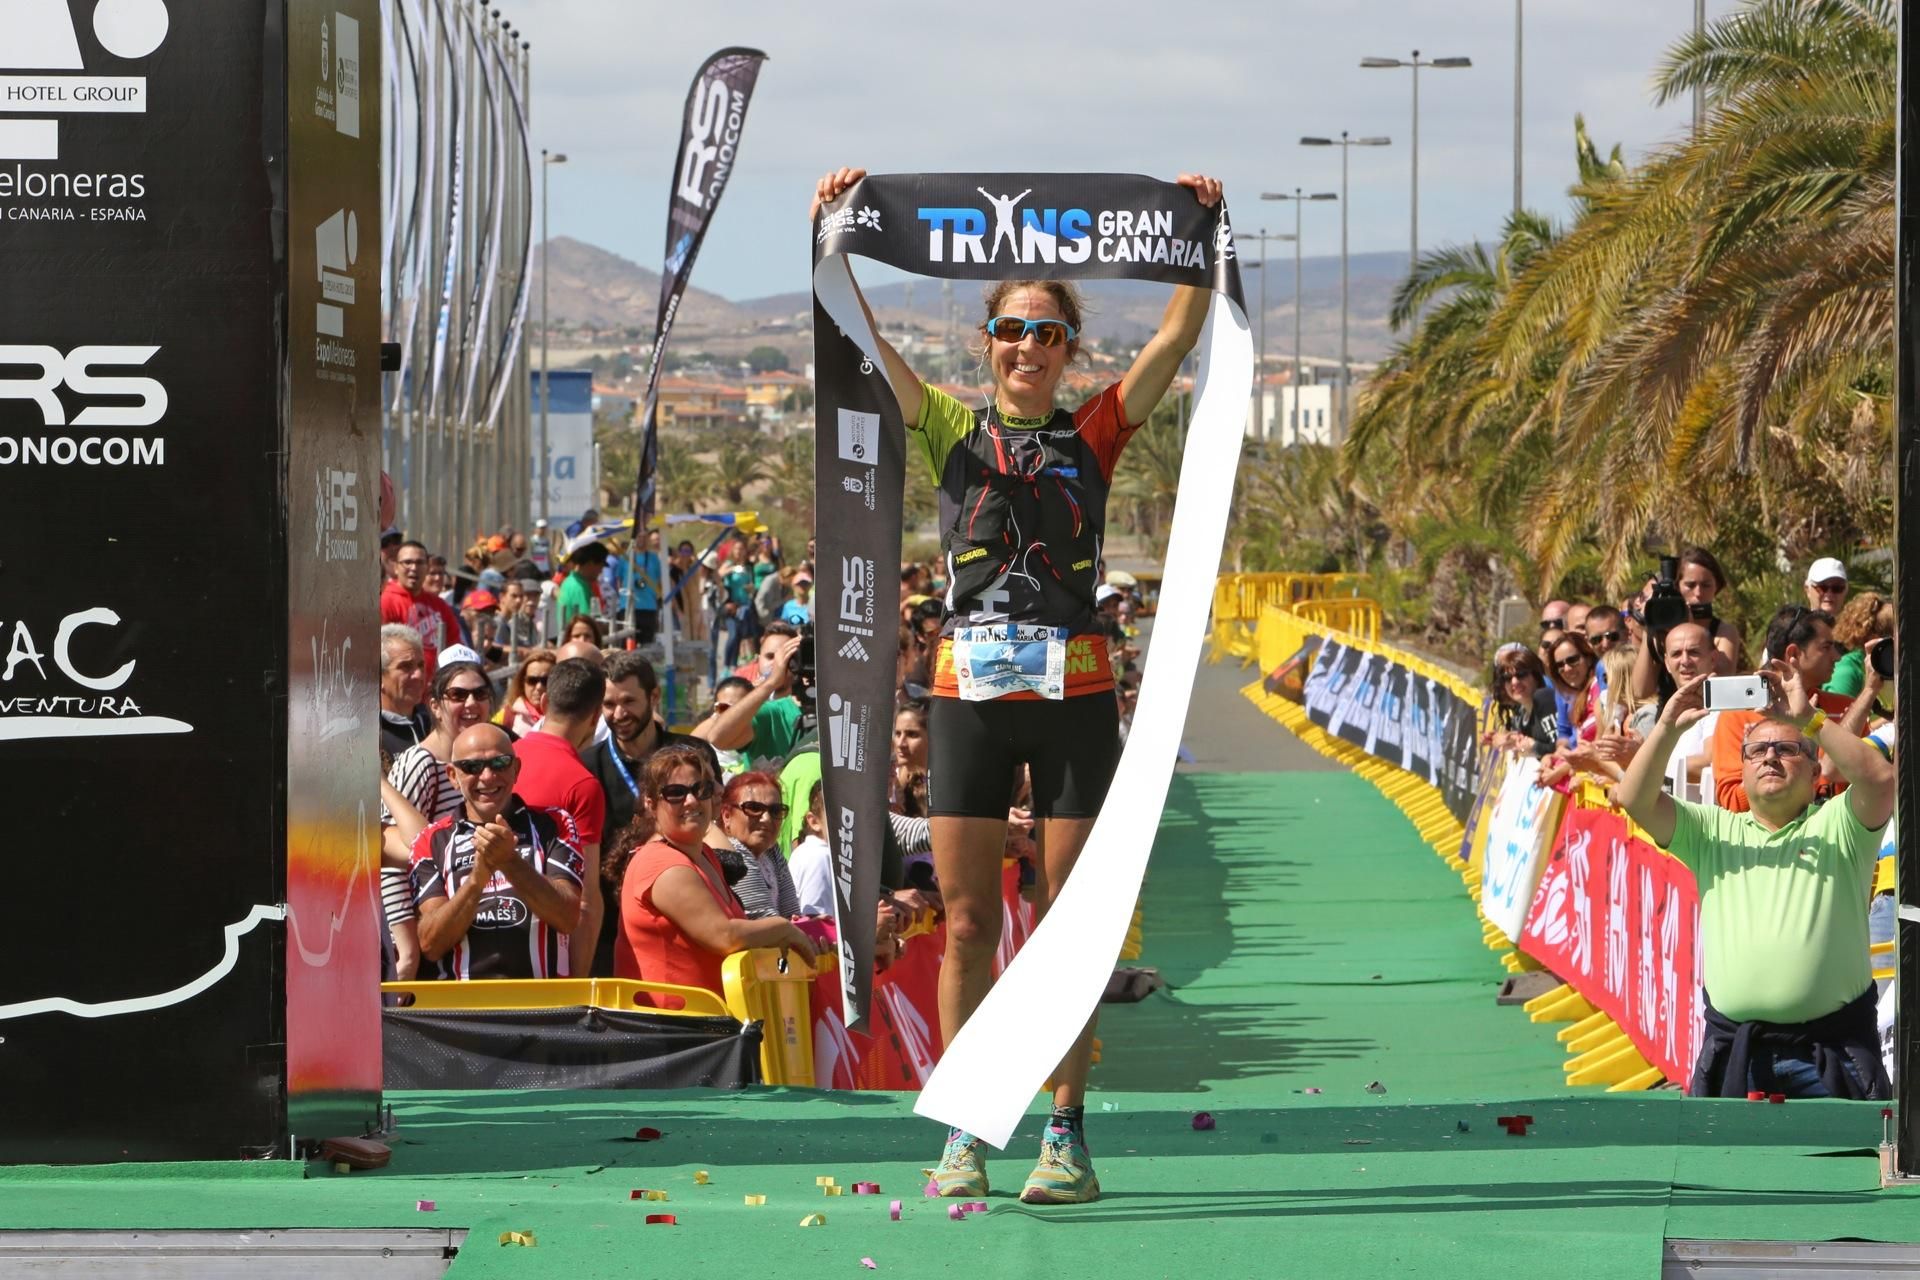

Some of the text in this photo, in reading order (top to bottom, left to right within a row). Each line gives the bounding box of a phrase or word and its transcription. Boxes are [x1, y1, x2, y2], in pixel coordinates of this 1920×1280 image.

[8, 86, 138, 101] HOTEL GROUP
[677, 76, 729, 208] RS
[8, 207, 75, 221] CANARIA
[91, 206, 146, 222] ESPAÑA
[1098, 211, 1172, 237] GRAN
[1097, 236, 1206, 270] CANARIA
[0, 345, 168, 426] RS
[865, 560, 875, 624] SONOCOM
